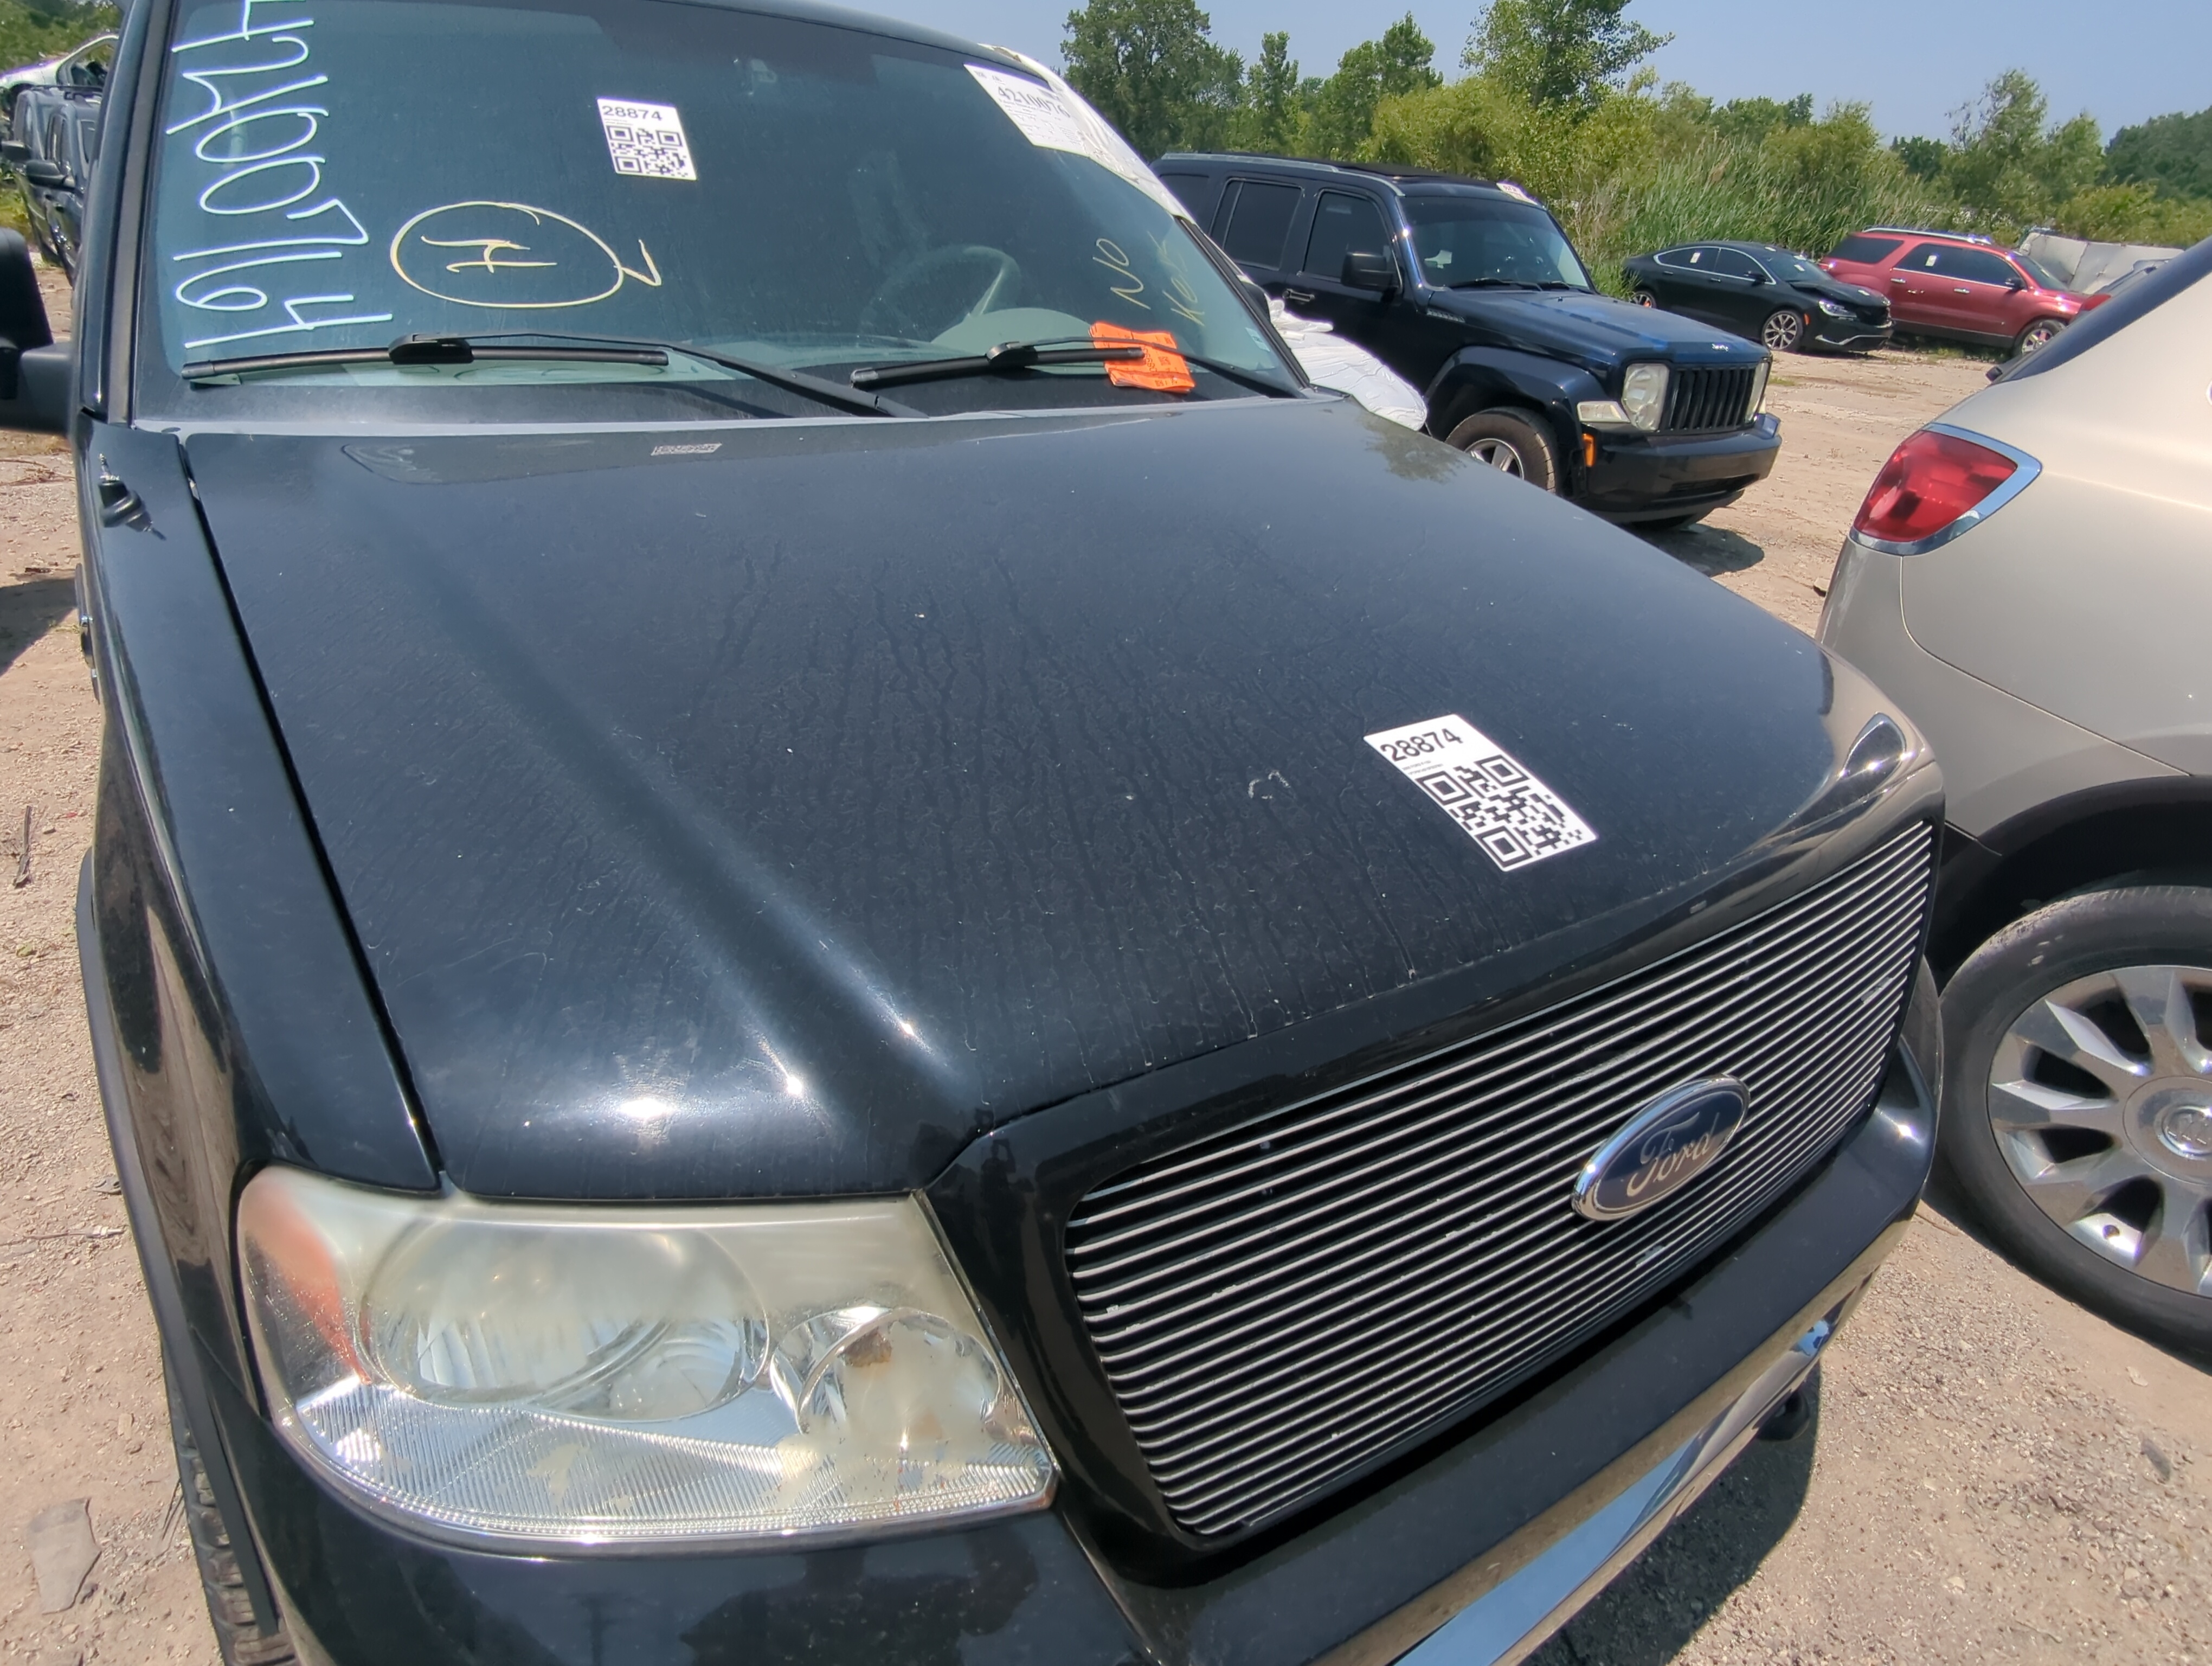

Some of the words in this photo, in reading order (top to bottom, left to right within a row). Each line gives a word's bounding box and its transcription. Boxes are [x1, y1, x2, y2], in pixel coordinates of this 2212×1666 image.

[602, 105, 663, 121] 28874
[998, 86, 1071, 118] 4210076
[1092, 238, 1152, 310] NO
[1380, 728, 1463, 762] 28874
[1626, 1112, 1720, 1197] Ford
